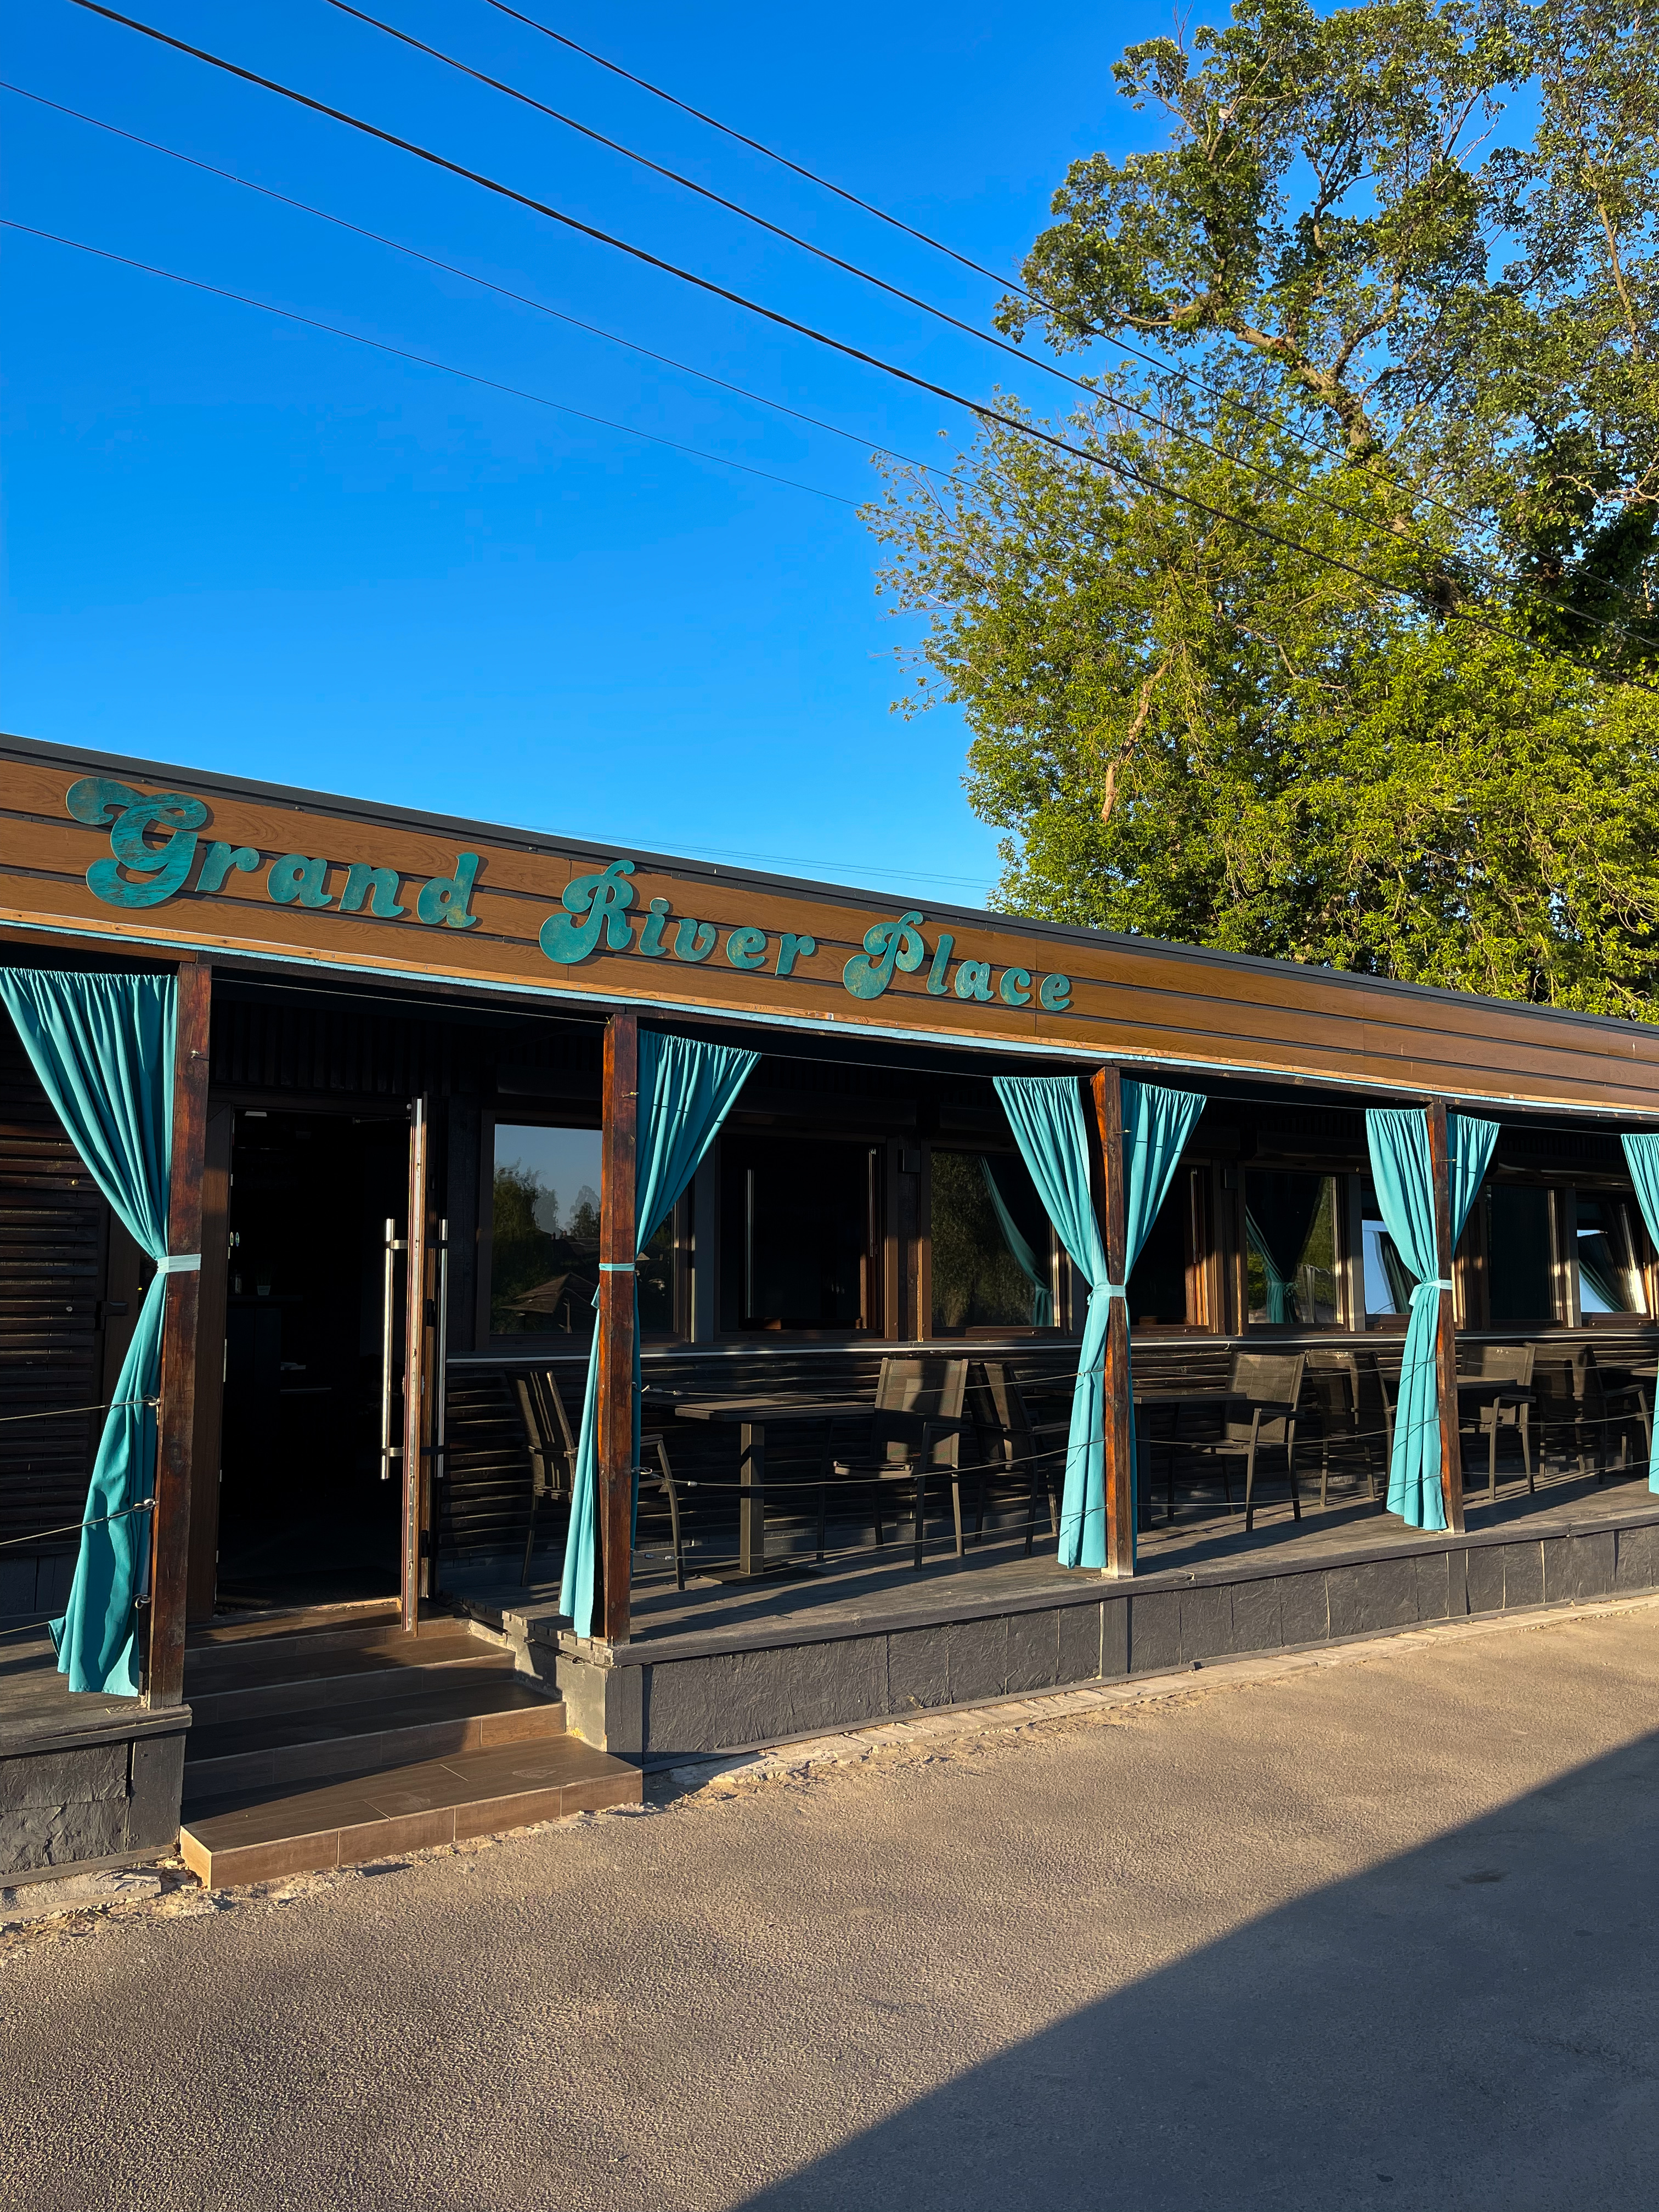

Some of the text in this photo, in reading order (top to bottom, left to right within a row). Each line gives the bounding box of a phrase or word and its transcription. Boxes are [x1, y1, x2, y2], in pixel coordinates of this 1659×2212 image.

[66, 776, 1071, 1011] Grand River Place
